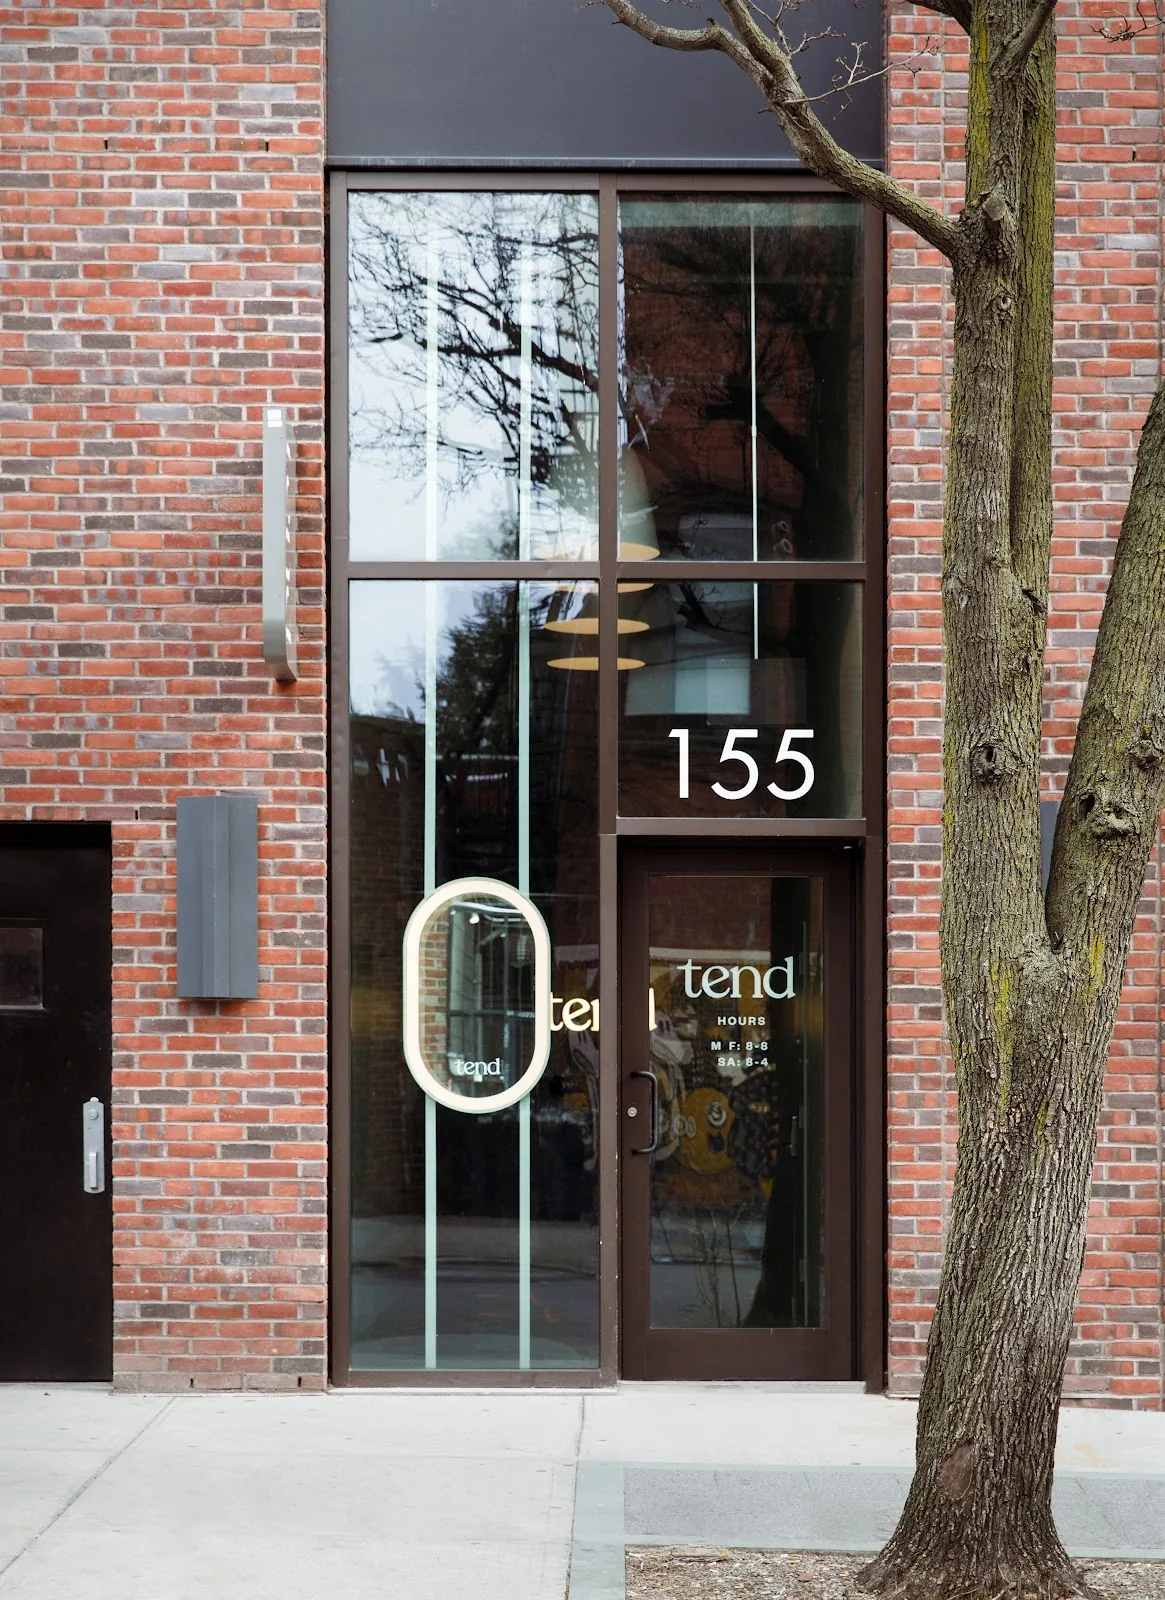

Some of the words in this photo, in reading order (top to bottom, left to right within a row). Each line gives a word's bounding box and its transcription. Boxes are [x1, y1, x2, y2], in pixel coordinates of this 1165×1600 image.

[668, 728, 815, 800] 155
[676, 956, 796, 999] tend
[717, 1016, 766, 1026] HOURS
[710, 1041, 722, 1051] M
[728, 1041, 741, 1051] F:
[745, 1041, 768, 1051] 8-8
[454, 1057, 501, 1076] tend
[717, 1057, 741, 1067] SA:
[745, 1057, 769, 1067] 8-4
